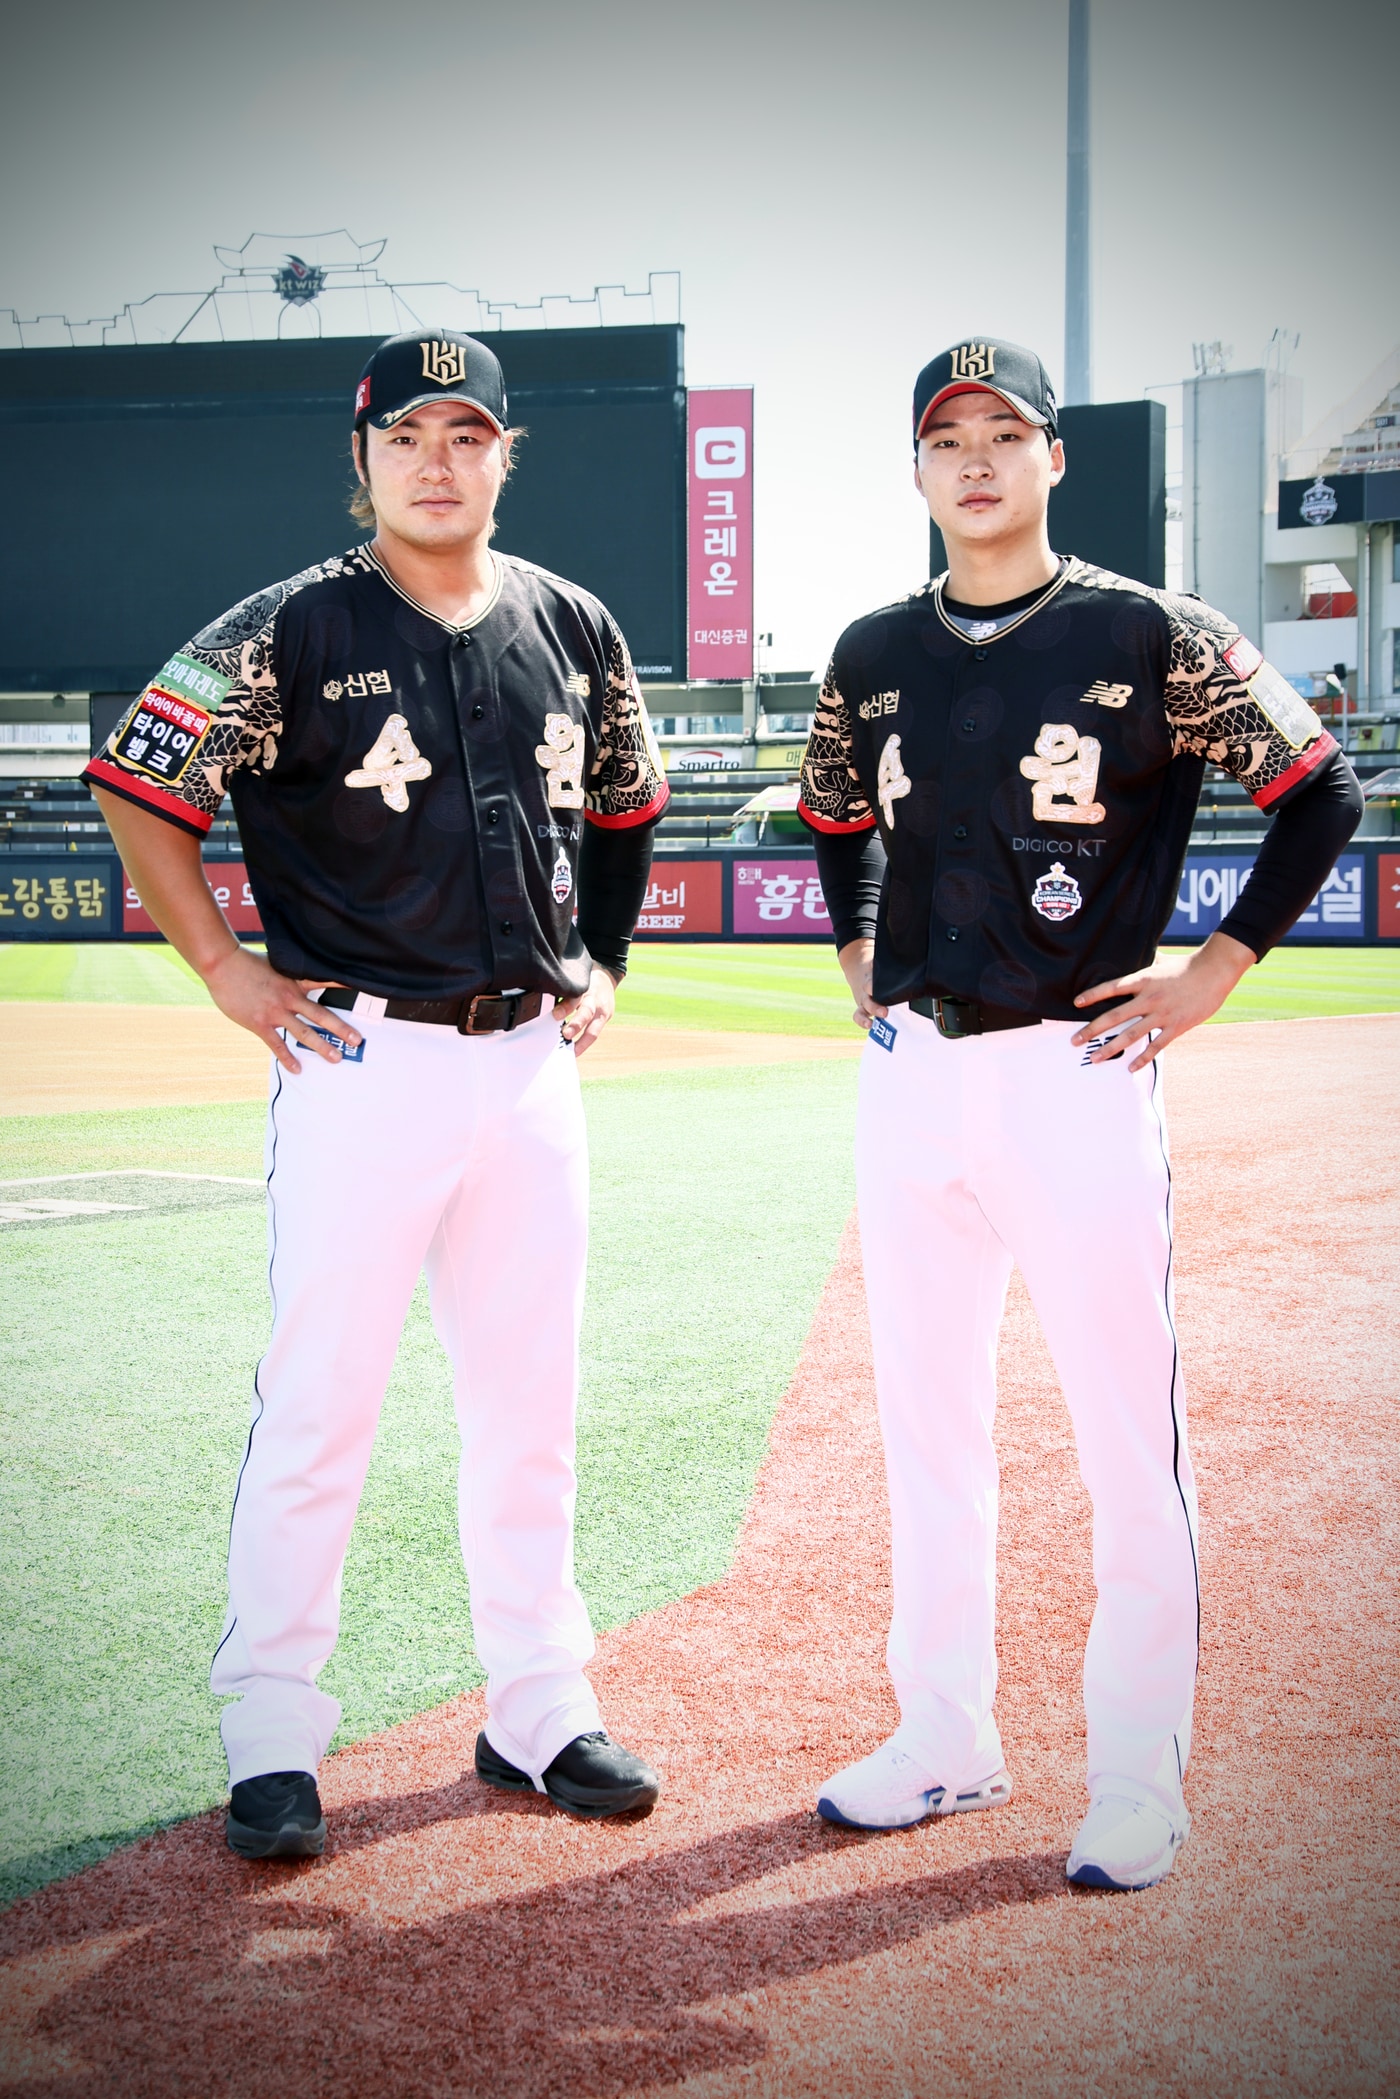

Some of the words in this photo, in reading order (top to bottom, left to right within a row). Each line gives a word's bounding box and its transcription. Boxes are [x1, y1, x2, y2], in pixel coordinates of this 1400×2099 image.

[703, 491, 738, 595] 크레온
[694, 629, 747, 645] 대신증권
[344, 669, 393, 698] 신협
[868, 689, 900, 719] 신협
[132, 712, 195, 757] 타이어
[126, 736, 173, 773] 뱅크
[678, 759, 740, 771] Smartro
[1012, 837, 1073, 854] DIGICO
[1077, 839, 1107, 857] KT
[637, 915, 685, 929] BEEF
